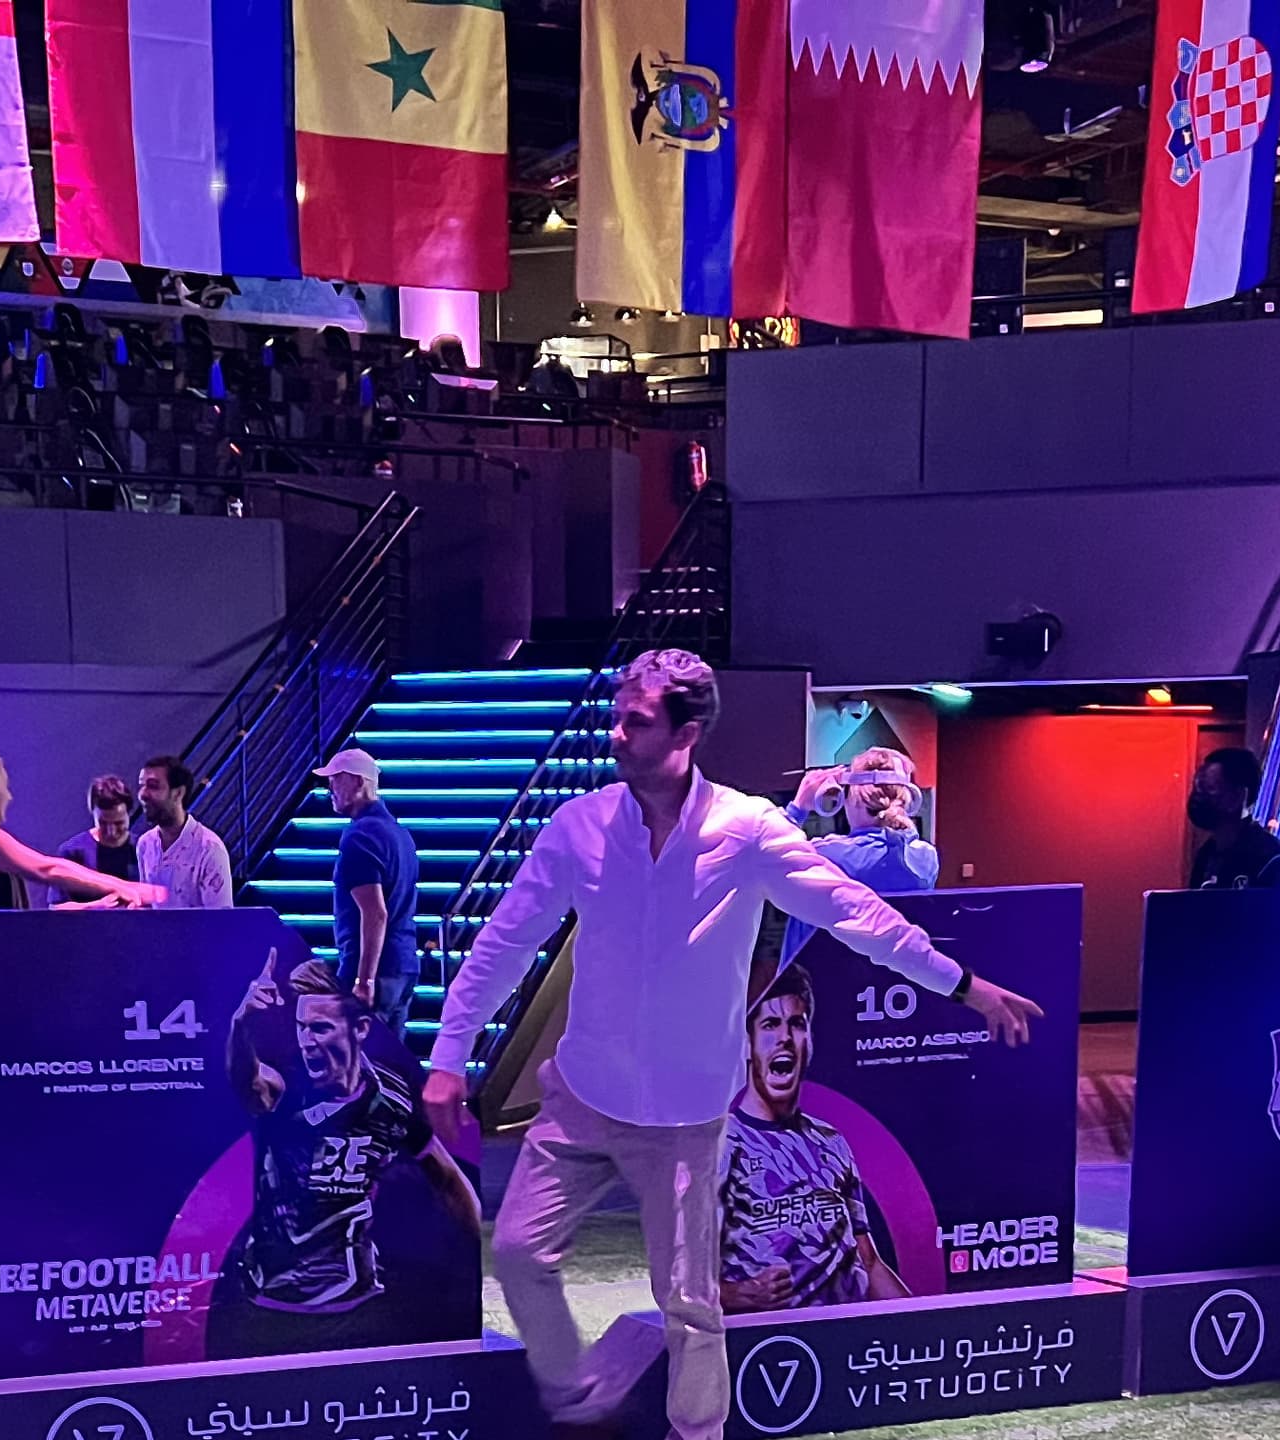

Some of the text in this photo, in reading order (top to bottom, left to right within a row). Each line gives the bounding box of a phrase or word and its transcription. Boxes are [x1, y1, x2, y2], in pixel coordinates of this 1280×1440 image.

[856, 984, 918, 1021] 10
[123, 999, 208, 1041] 14
[856, 1031, 990, 1050] MARCO ASENSIO
[1, 1057, 205, 1077] MARCOS LLORENTE
[752, 1195, 816, 1218] SUPER
[777, 1205, 848, 1228] PLAYER
[936, 1215, 1059, 1249] HEADER
[972, 1241, 1059, 1272] MODE
[35, 1287, 193, 1321] METAVERSE
